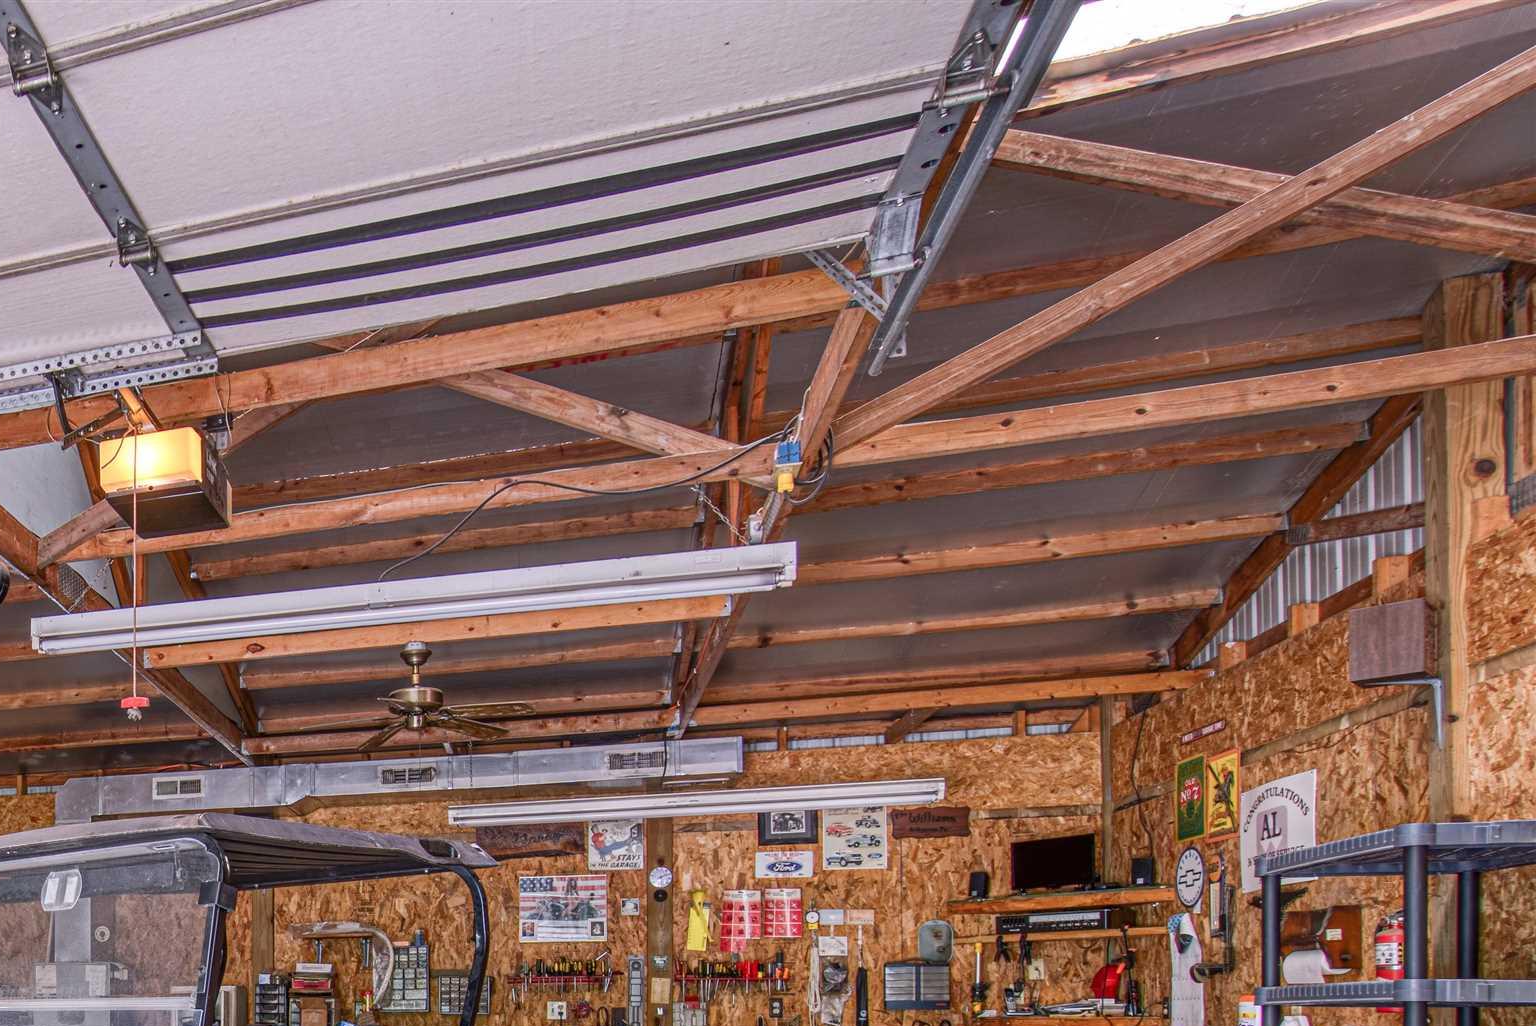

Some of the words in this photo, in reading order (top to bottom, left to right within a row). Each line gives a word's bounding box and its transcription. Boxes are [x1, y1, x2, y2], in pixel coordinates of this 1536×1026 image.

[1243, 786, 1311, 833] CONGRATULATIONS
[1260, 811, 1282, 841] AL
[616, 854, 641, 862] STAYS
